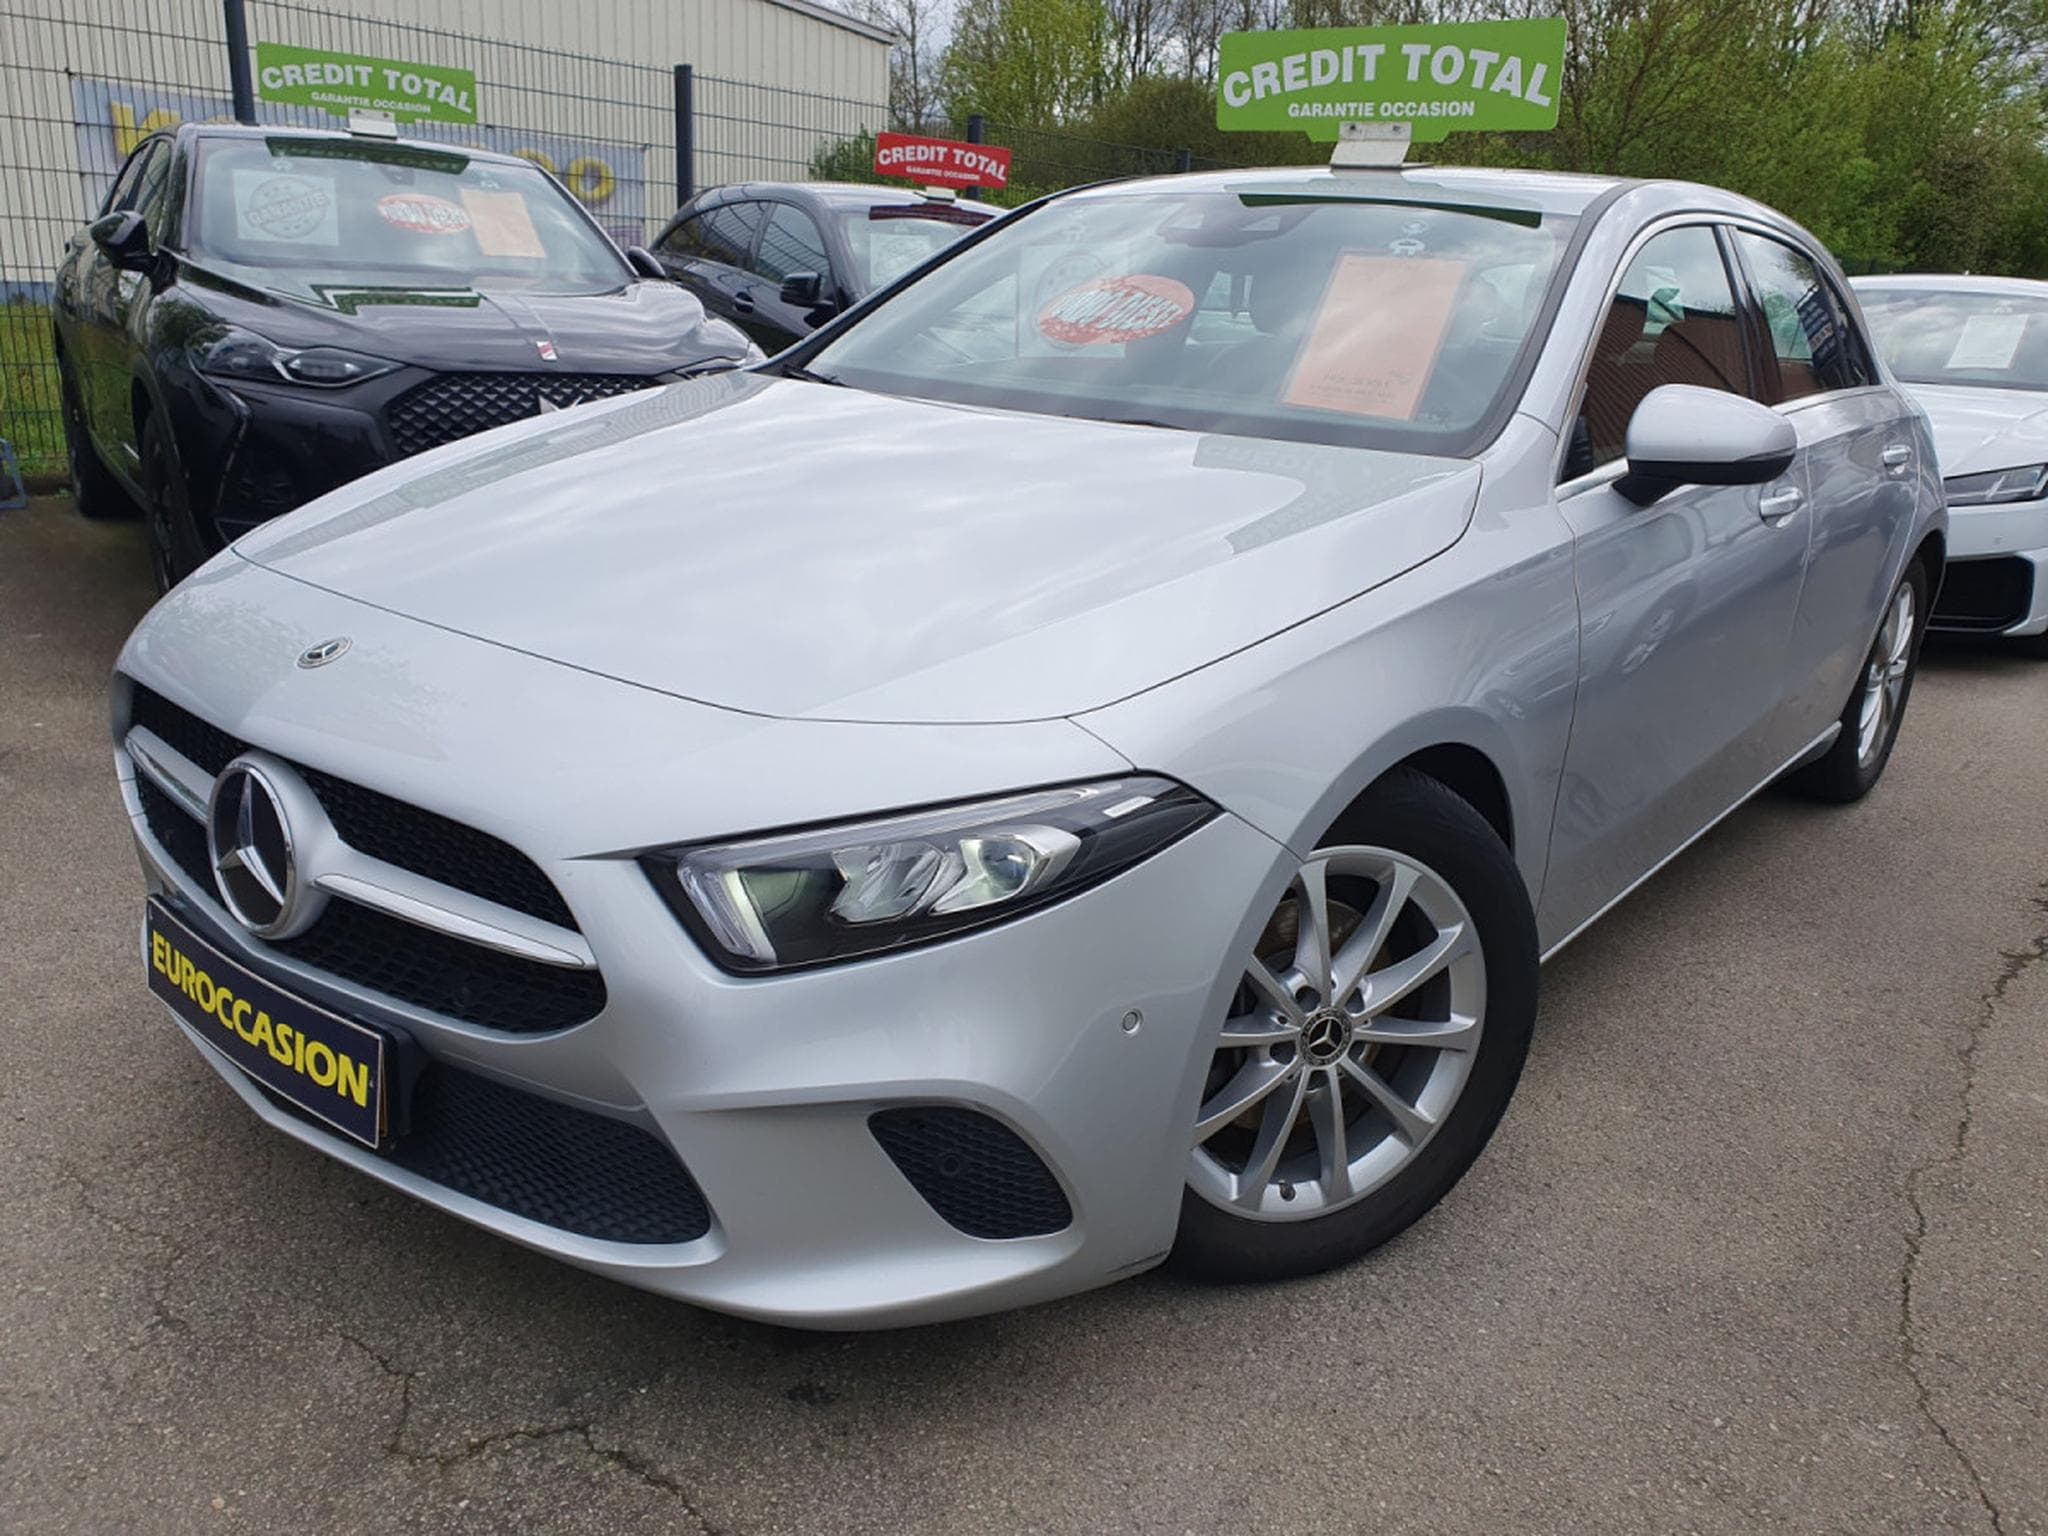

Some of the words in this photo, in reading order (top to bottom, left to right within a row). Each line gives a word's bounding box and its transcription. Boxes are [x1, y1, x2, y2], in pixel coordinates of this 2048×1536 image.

[261, 63, 374, 90] CREDIT
[383, 68, 473, 114] TOTAL
[1223, 44, 1386, 108] CREDIT
[1401, 44, 1552, 108] TOTAL
[311, 91, 370, 107] GARANTIE
[373, 99, 431, 113] OCCASION
[1288, 102, 1374, 118] GARANTIE
[1380, 101, 1475, 118] OCCASION
[878, 145, 949, 166] CREDIT
[953, 148, 1007, 181] TOTAL
[152, 930, 369, 1108] EUROCCASION
